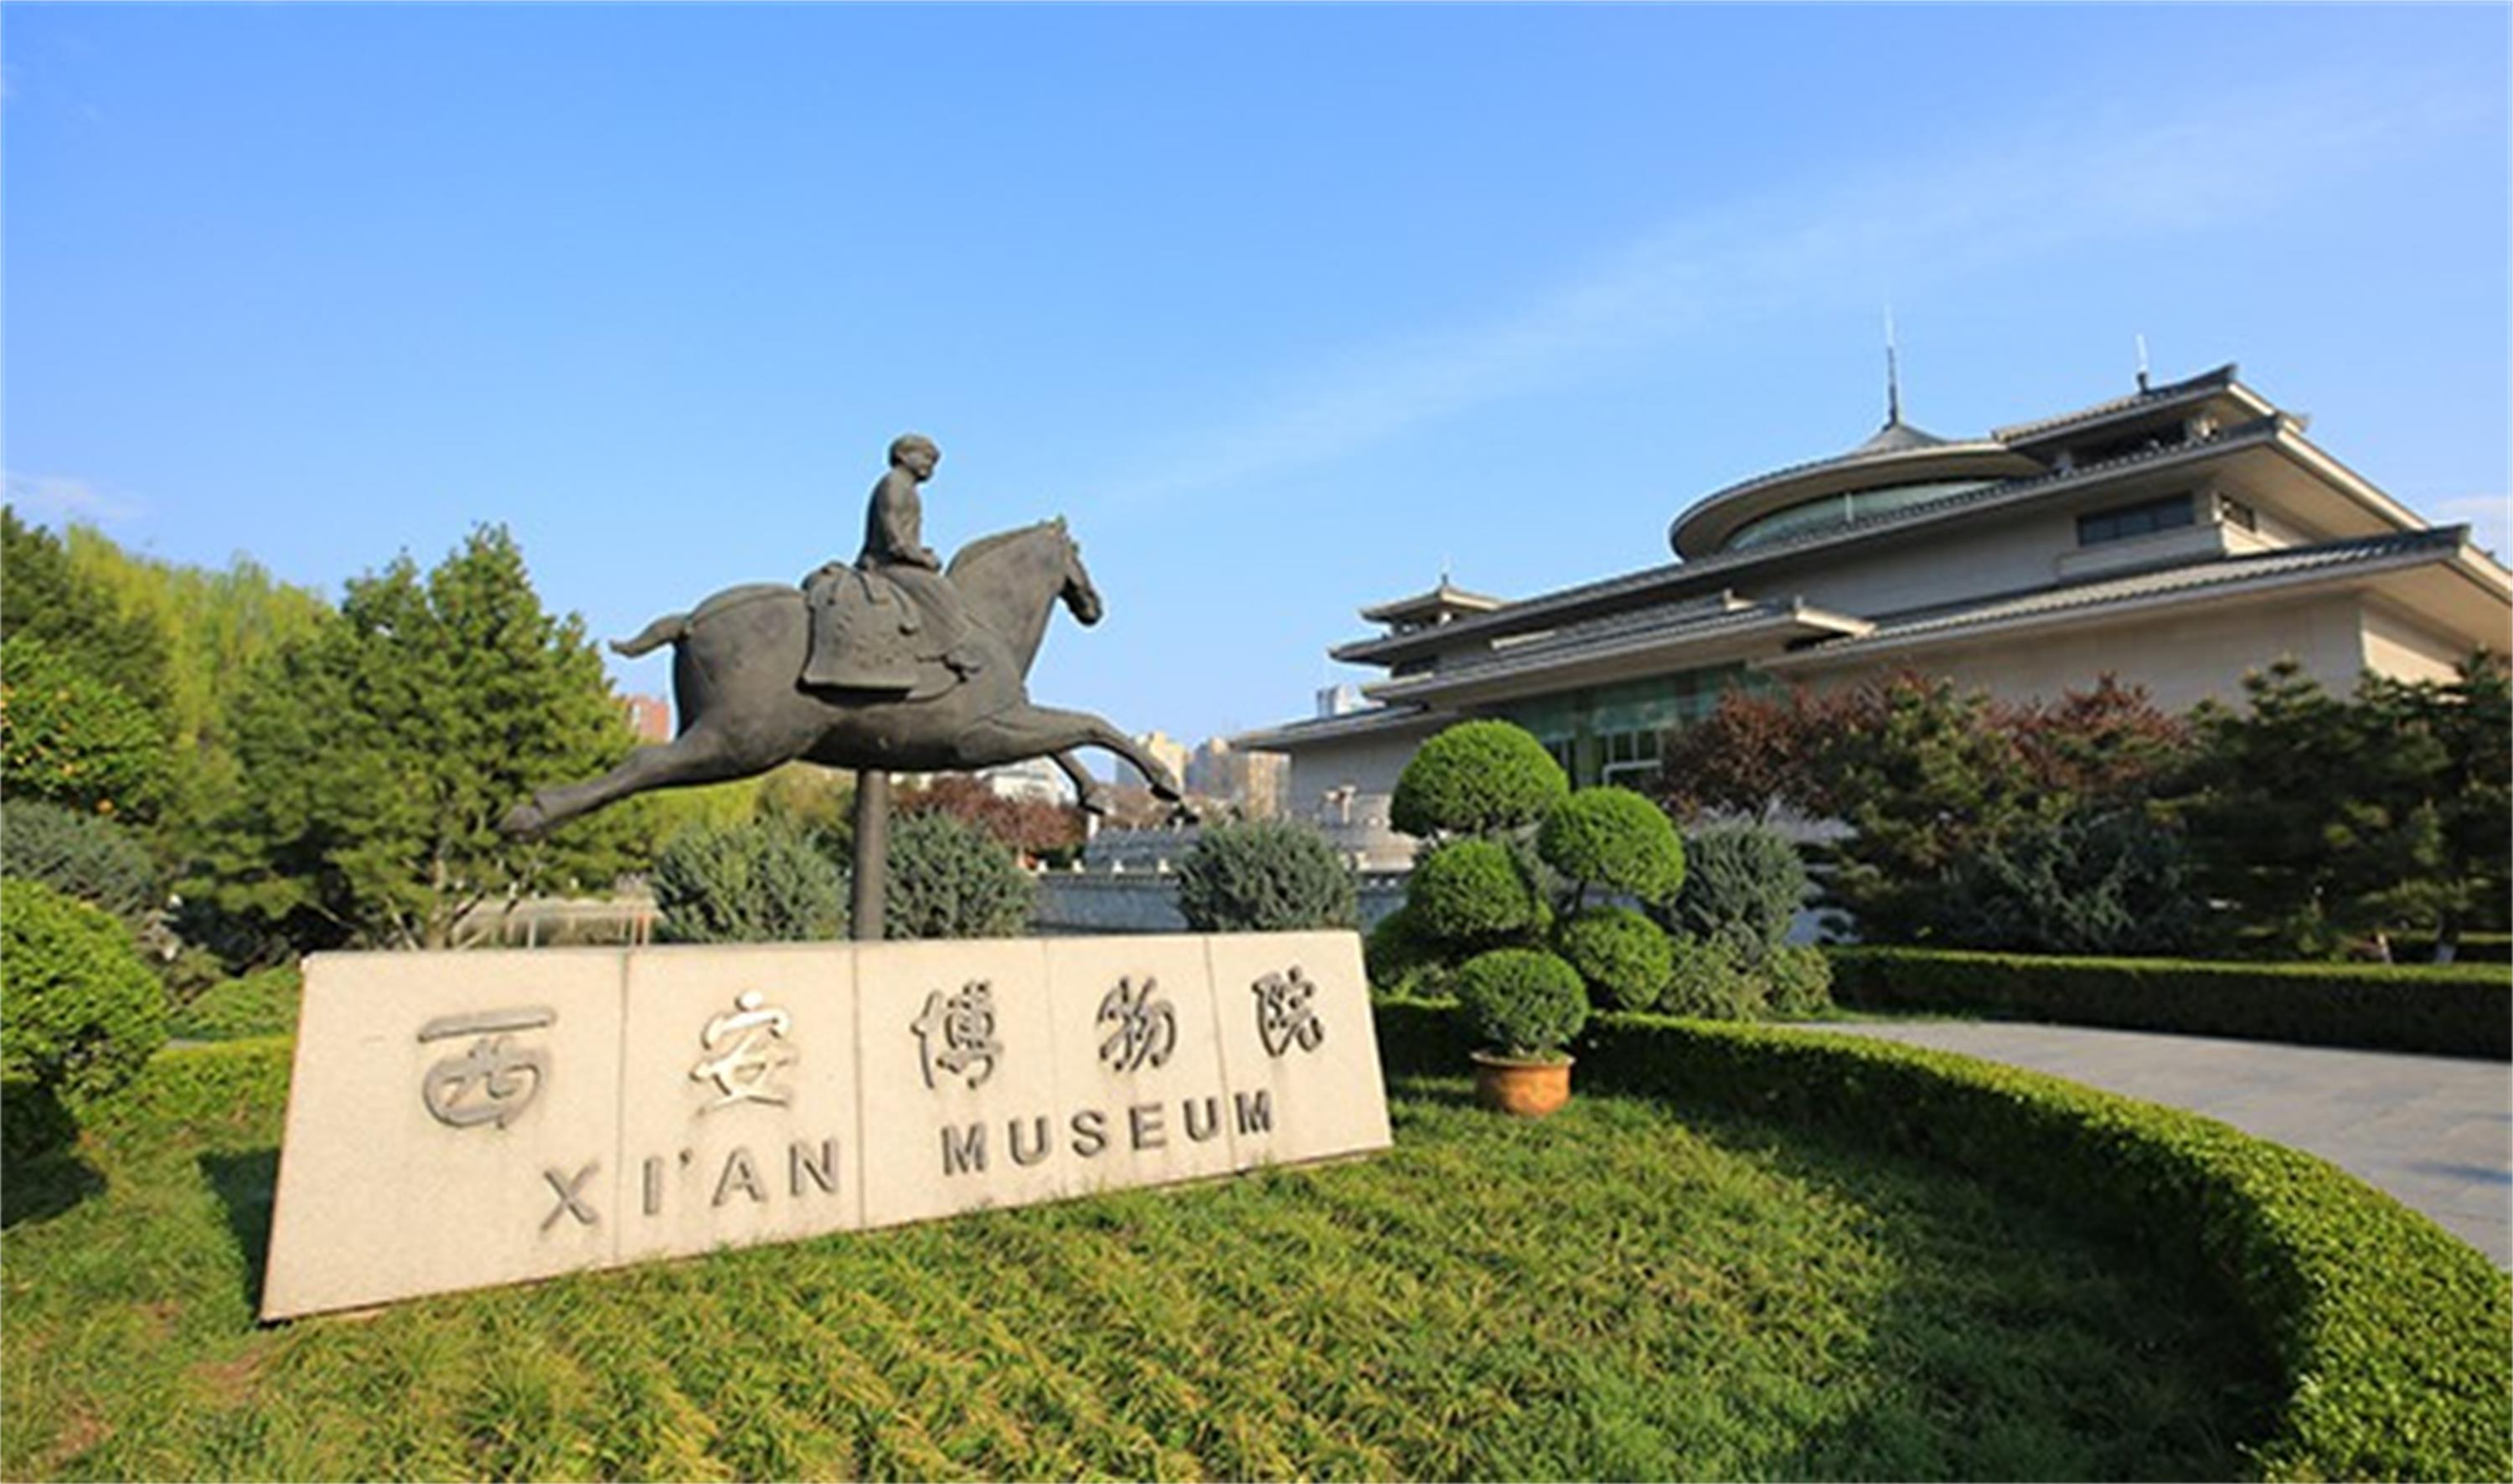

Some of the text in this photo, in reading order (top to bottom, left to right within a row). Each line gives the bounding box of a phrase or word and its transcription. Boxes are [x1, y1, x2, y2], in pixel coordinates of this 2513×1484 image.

[418, 967, 1324, 1130] 西安博物院
[541, 1090, 1274, 1230] XI'AN MUSEUM
